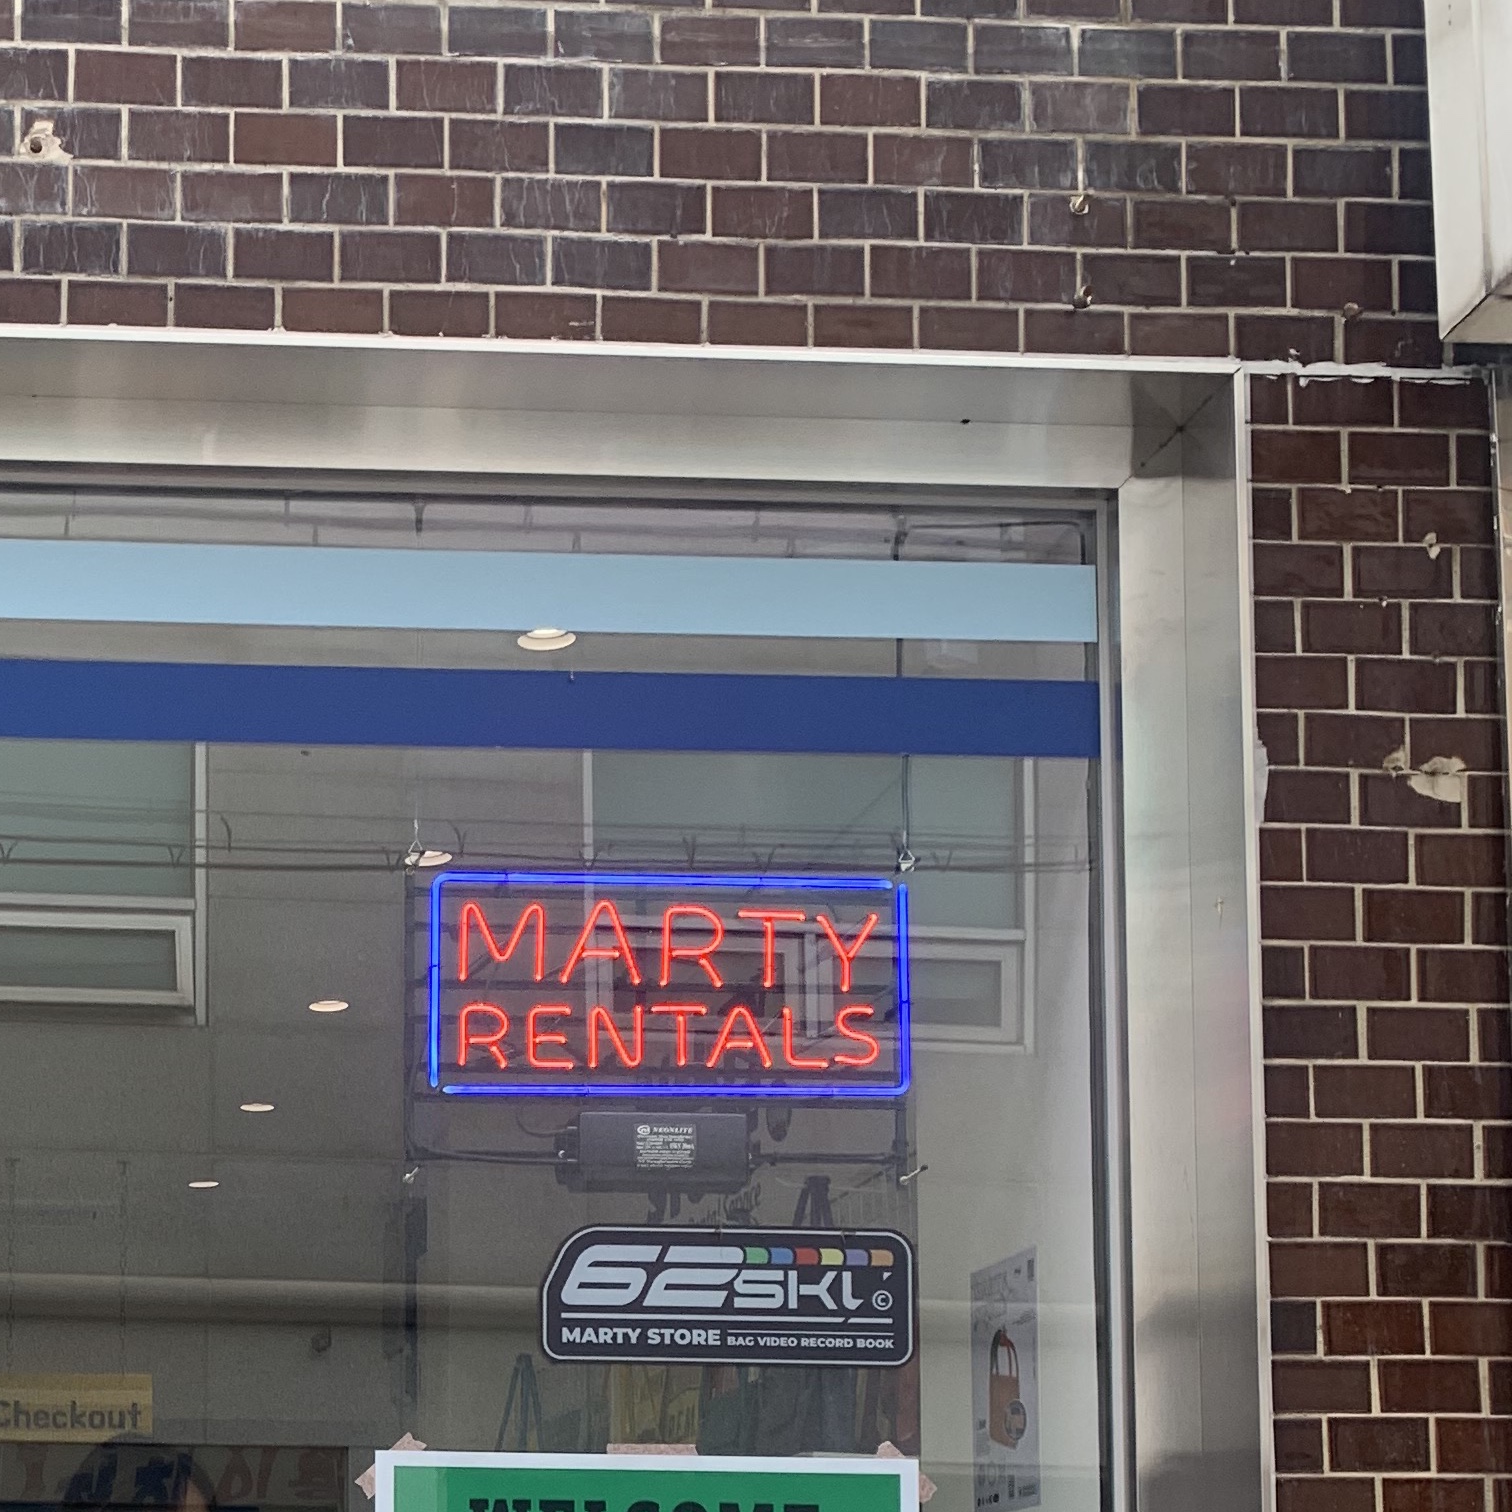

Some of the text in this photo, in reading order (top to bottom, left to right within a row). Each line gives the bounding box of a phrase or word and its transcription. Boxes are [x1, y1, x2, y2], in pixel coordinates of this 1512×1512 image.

[457, 899, 880, 992] MARTY
[456, 1002, 881, 1070] RENTALS
[561, 1326, 894, 1350] MARTY STORE BAG VIDEO RECORD BOOK
